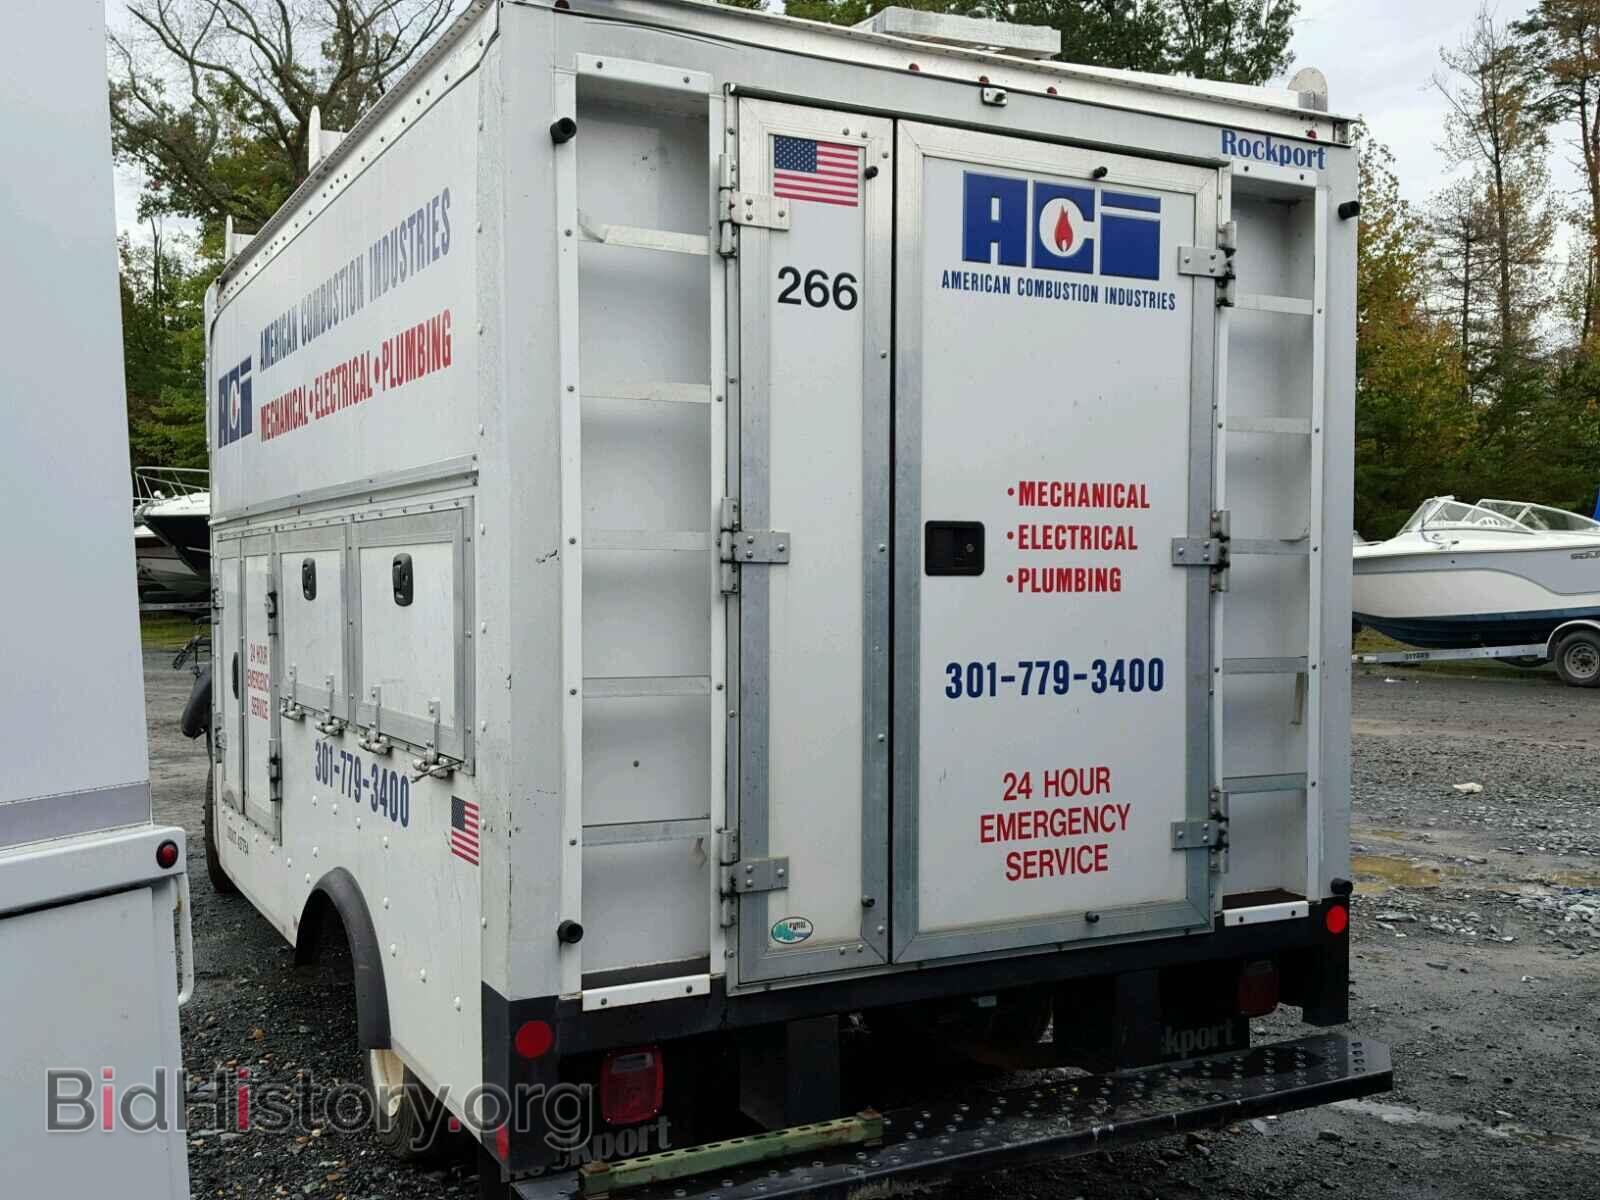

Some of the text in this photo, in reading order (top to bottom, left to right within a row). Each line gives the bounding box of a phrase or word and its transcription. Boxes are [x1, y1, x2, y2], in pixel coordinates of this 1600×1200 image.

[1222, 127, 1327, 171] Rockport
[259, 187, 450, 373] AMERICAN COMBUSTION INDUSTRIES
[776, 264, 859, 312] 266
[941, 269, 1177, 312] AMERICAN COMBUSTION INDUSTRIES
[260, 308, 452, 443] MECHANICAL ELECTRICAL PLUMBING
[1018, 481, 1150, 509] MECHANICAL
[1018, 525, 1138, 550] ELECTRICAL
[1017, 567, 1122, 593] PLUMBING
[945, 658, 1164, 699] 301-779-3400
[315, 738, 410, 828] 301-779-3400
[1003, 767, 1111, 801] 24 HOUR
[980, 803, 1131, 843] EMERGENCY
[1006, 844, 1109, 881] SERVICE
